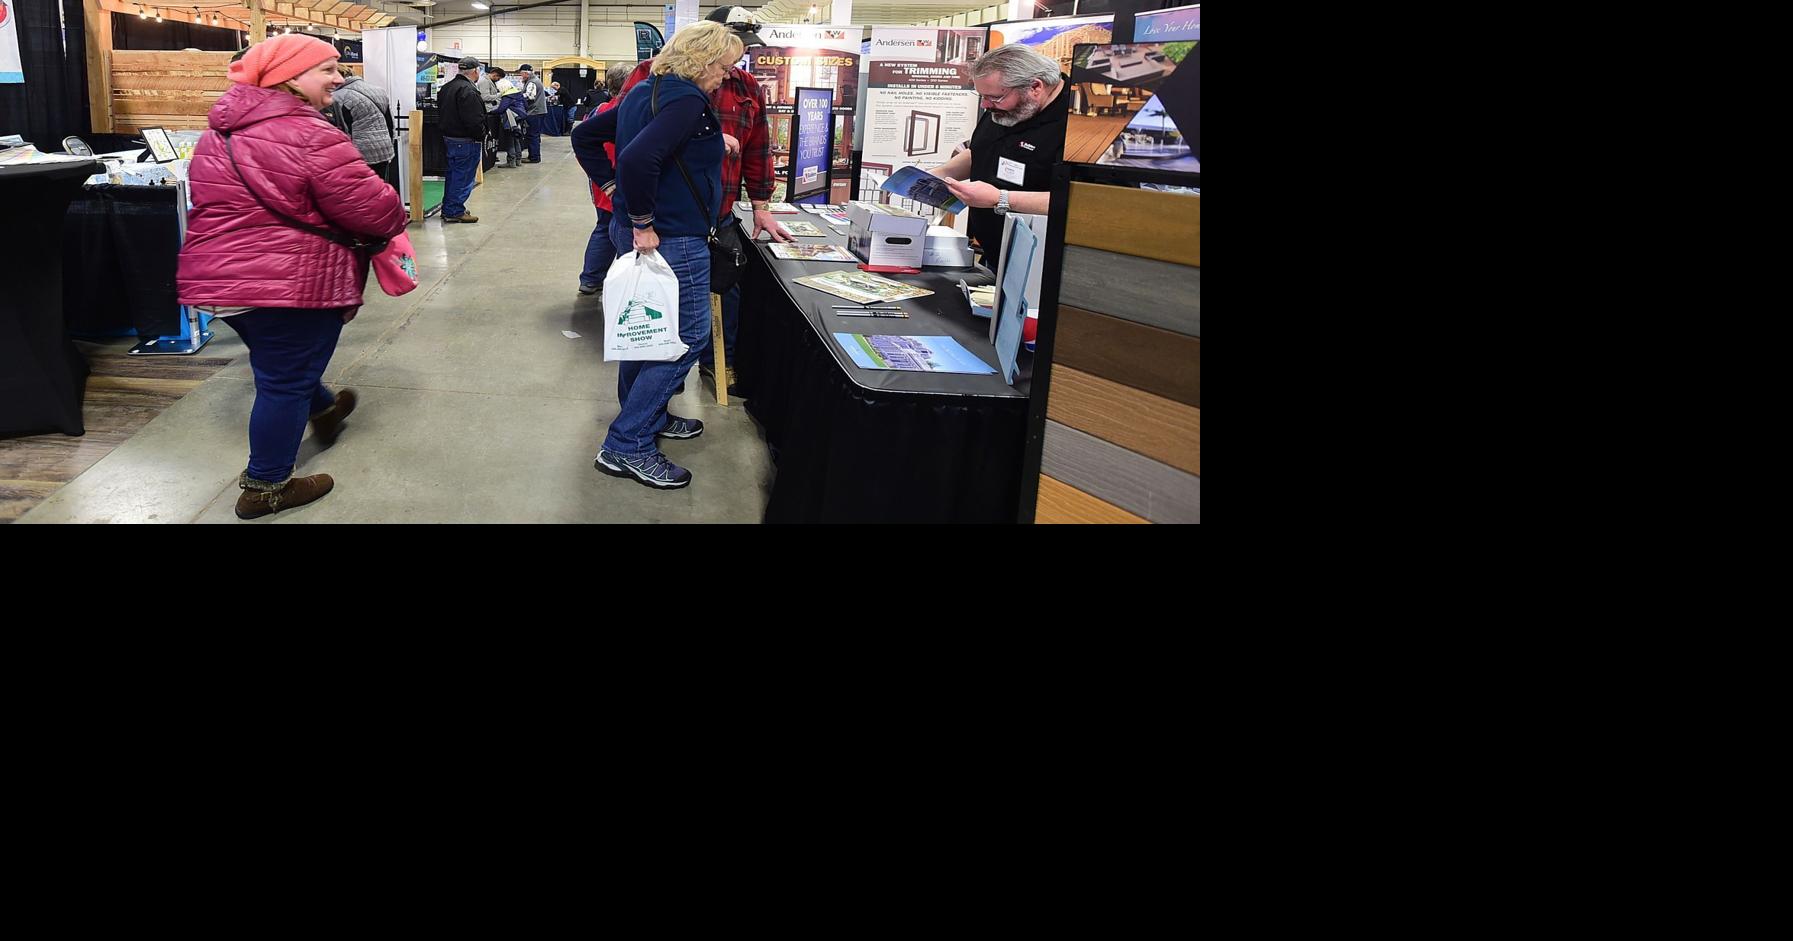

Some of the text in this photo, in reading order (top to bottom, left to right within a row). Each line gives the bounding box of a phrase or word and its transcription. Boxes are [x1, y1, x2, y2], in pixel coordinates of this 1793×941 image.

[1164, 21, 1180, 33] Your
[1182, 20, 1201, 31] Hom
[875, 39, 915, 47] Andersen
[815, 56, 853, 67] SIZES
[803, 98, 828, 109] OVER 100
[807, 111, 824, 121] YEARS
[799, 137, 808, 147] THE
[800, 147, 825, 160] YOU TRUST
